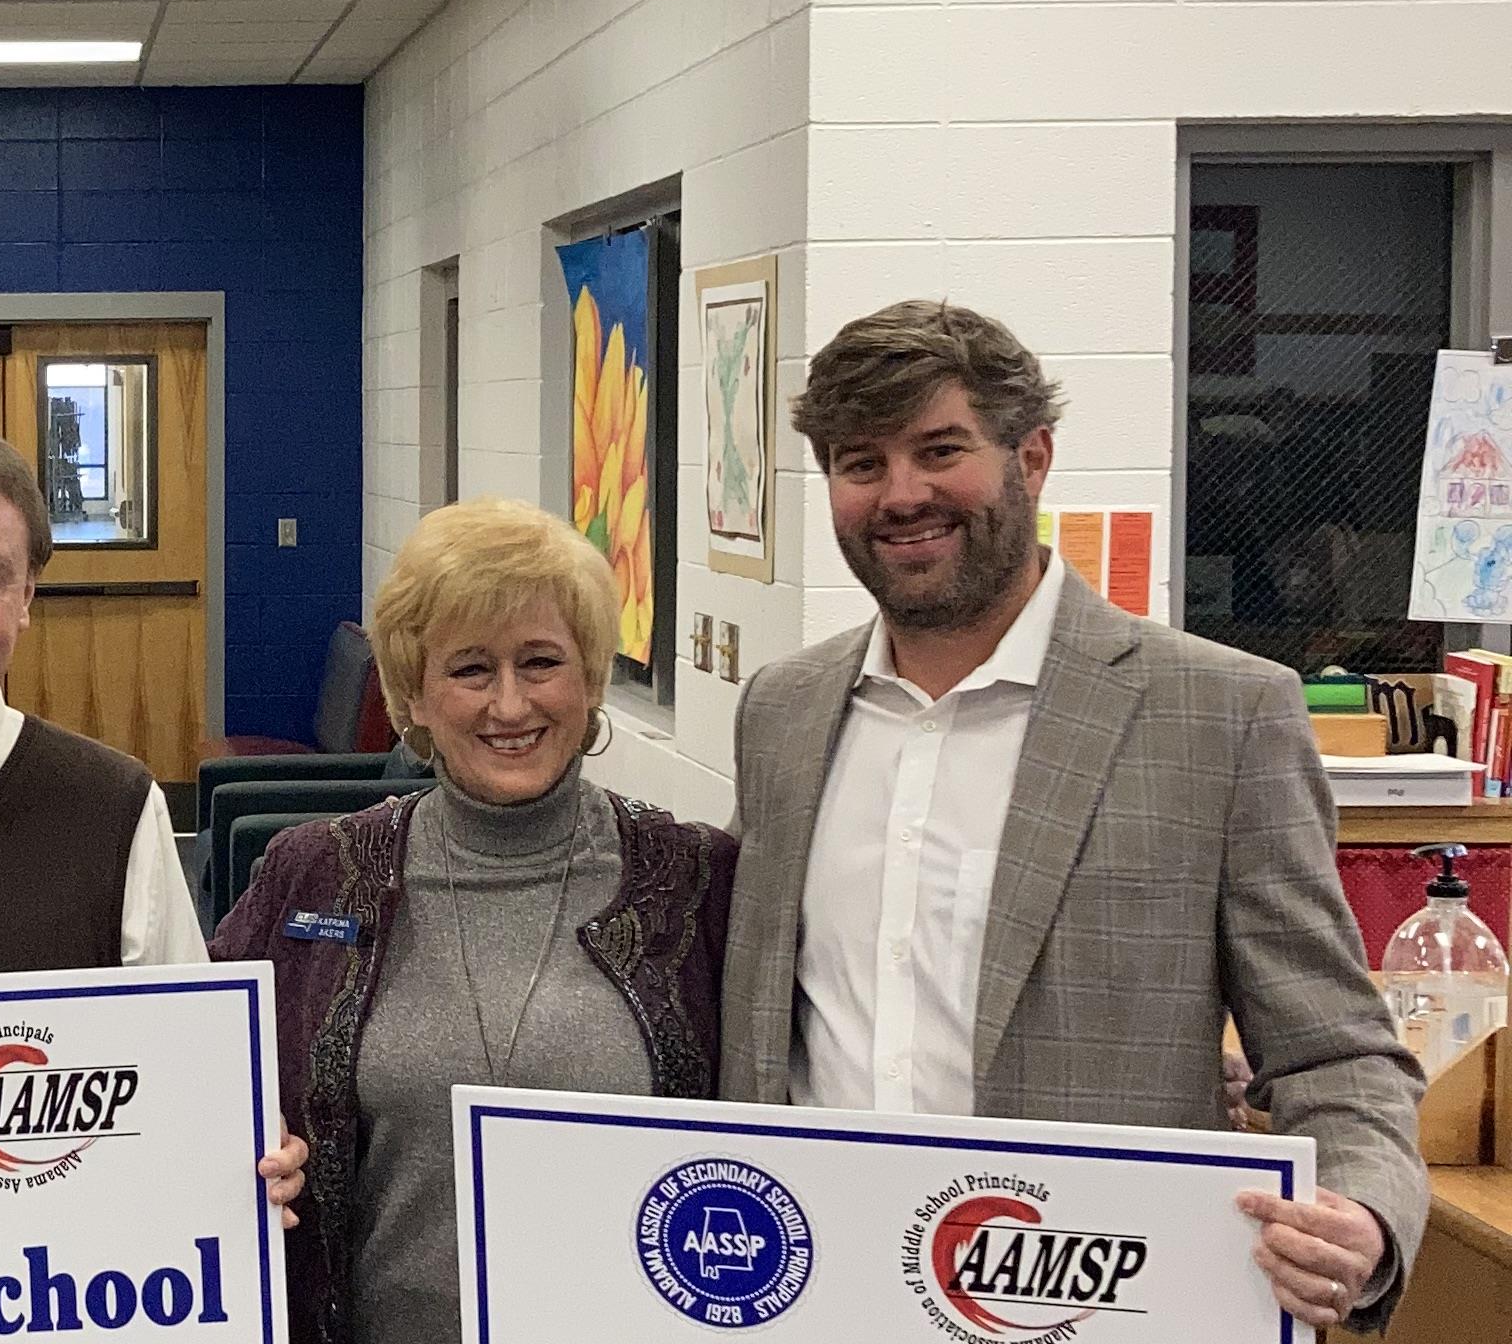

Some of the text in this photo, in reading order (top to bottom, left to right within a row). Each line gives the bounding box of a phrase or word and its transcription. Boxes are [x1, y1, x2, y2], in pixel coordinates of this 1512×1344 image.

[26, 1150, 82, 1188] Alabama
[678, 1163, 772, 1193] SECONDARY
[964, 1172, 1050, 1202] Principals
[659, 1177, 680, 1200] OF
[915, 1179, 964, 1222] School
[766, 1186, 808, 1243] SCHOOL
[683, 1231, 766, 1257] AASSP
[901, 1223, 926, 1275] Middle
[644, 1249, 697, 1310] ALABAMA
[753, 1246, 809, 1318] PRINCIPALS
[906, 1274, 927, 1294] of
[948, 1230, 1147, 1303] AAMSP
[706, 1303, 743, 1323] 1928
